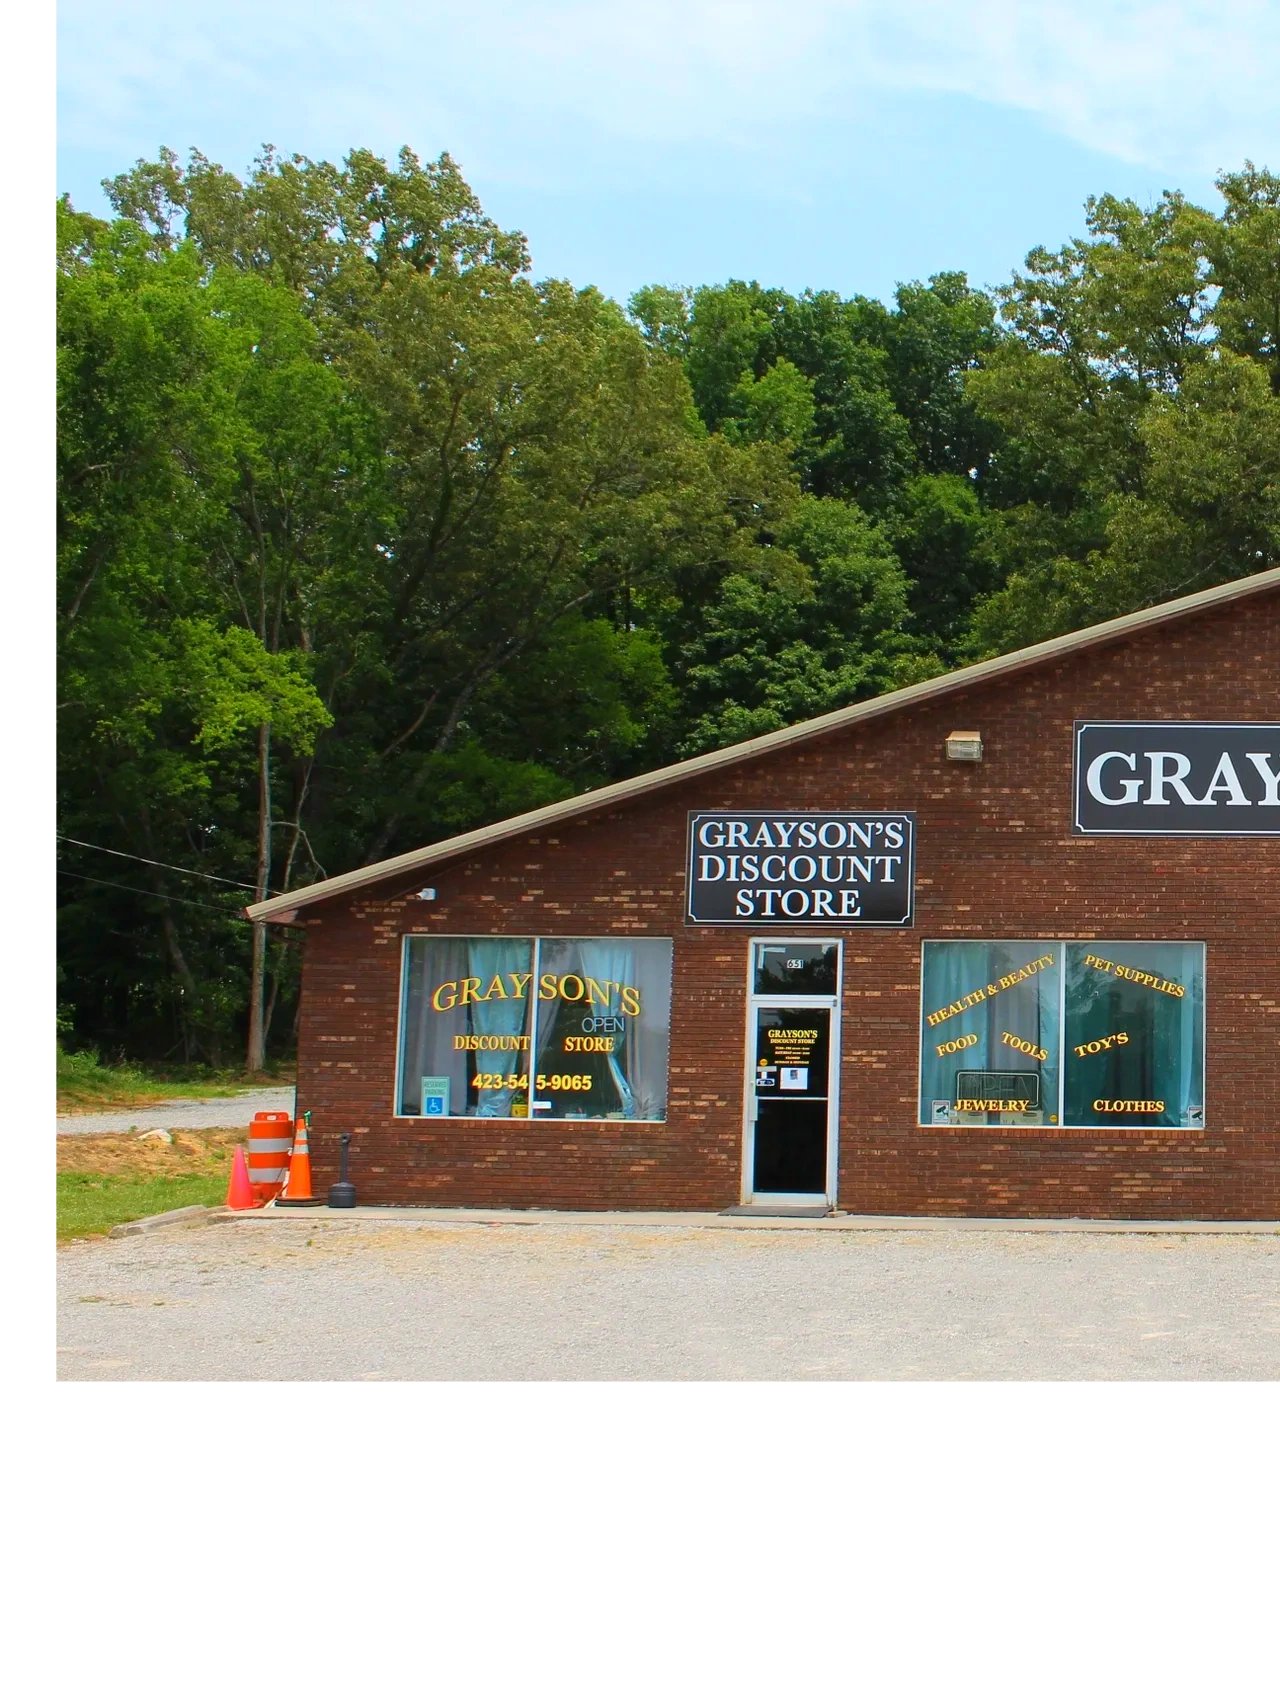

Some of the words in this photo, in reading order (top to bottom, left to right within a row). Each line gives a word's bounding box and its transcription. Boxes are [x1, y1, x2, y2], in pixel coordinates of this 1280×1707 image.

[699, 821, 904, 849] GRAYSON'S
[698, 854, 902, 883] DISCOUNT
[735, 888, 861, 917] STORE
[787, 960, 804, 968] 651
[1084, 954, 1115, 973] PET
[1114, 964, 1186, 999] SUPPLIES
[432, 973, 642, 1016] GRAYSON'S
[927, 988, 988, 1027] HEALTH
[986, 982, 999, 998] &
[999, 953, 1056, 992] BEAUTY
[581, 1017, 625, 1033] OPEN
[768, 1029, 818, 1038] GRAYSON'S
[453, 1034, 531, 1050] DISCOUNT
[564, 1036, 615, 1052] STORE
[935, 1033, 979, 1058] FOOD
[1001, 1031, 1050, 1062] TOOLS
[1074, 1032, 1130, 1058] TOY'S
[953, 1099, 1030, 1112] JEWELRY
[1093, 1100, 1165, 1113] CLOTHES
